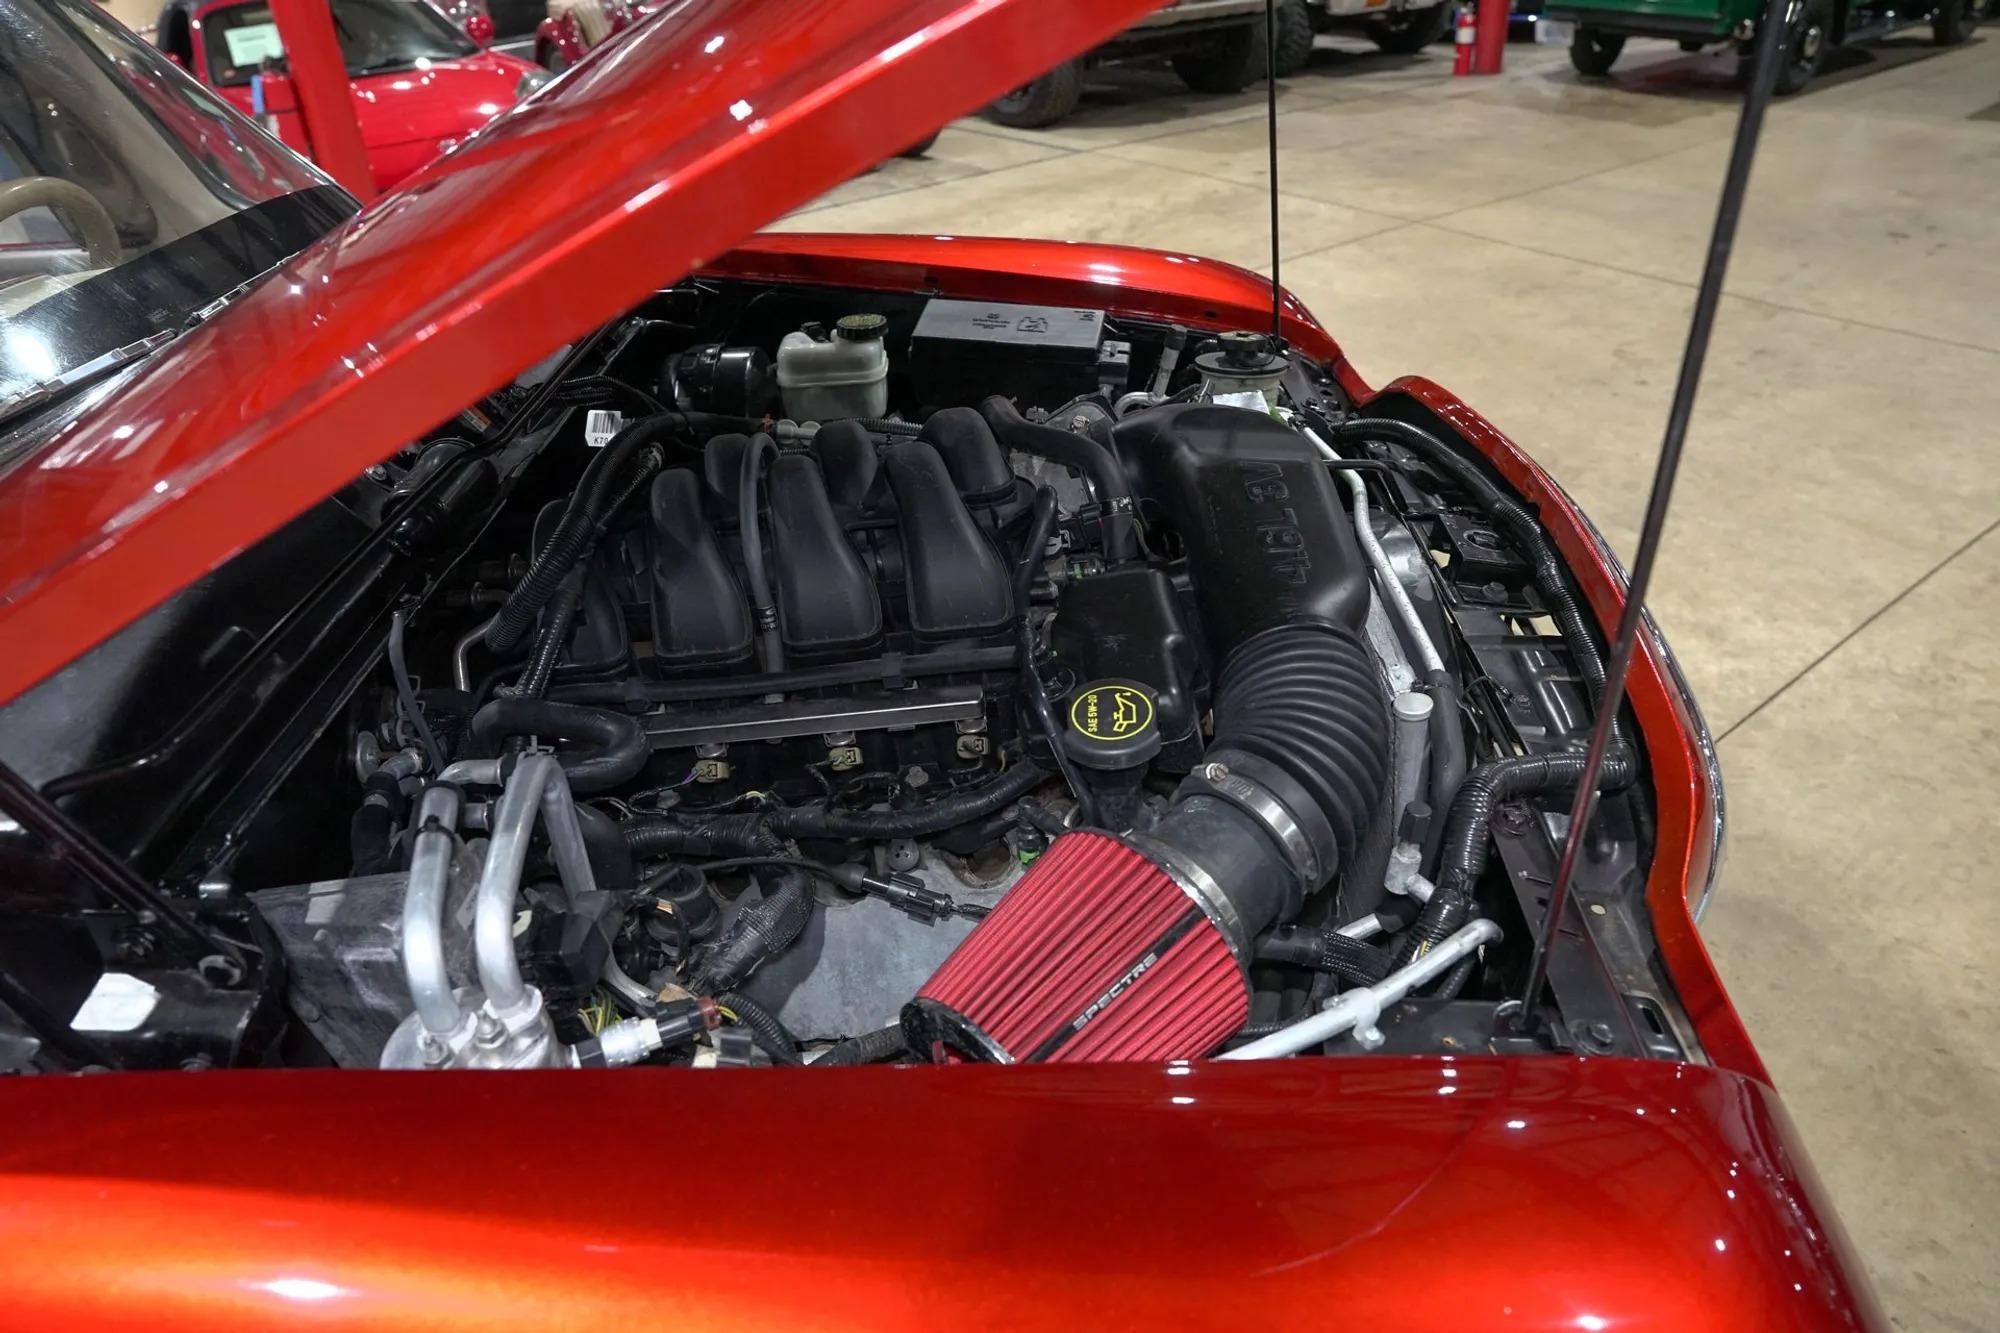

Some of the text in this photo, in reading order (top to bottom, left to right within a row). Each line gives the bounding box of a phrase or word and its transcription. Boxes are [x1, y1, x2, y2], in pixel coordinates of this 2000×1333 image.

[1087, 694, 1098, 732] SAE 5W-20
[1072, 952, 1158, 1030] SPECTRE
